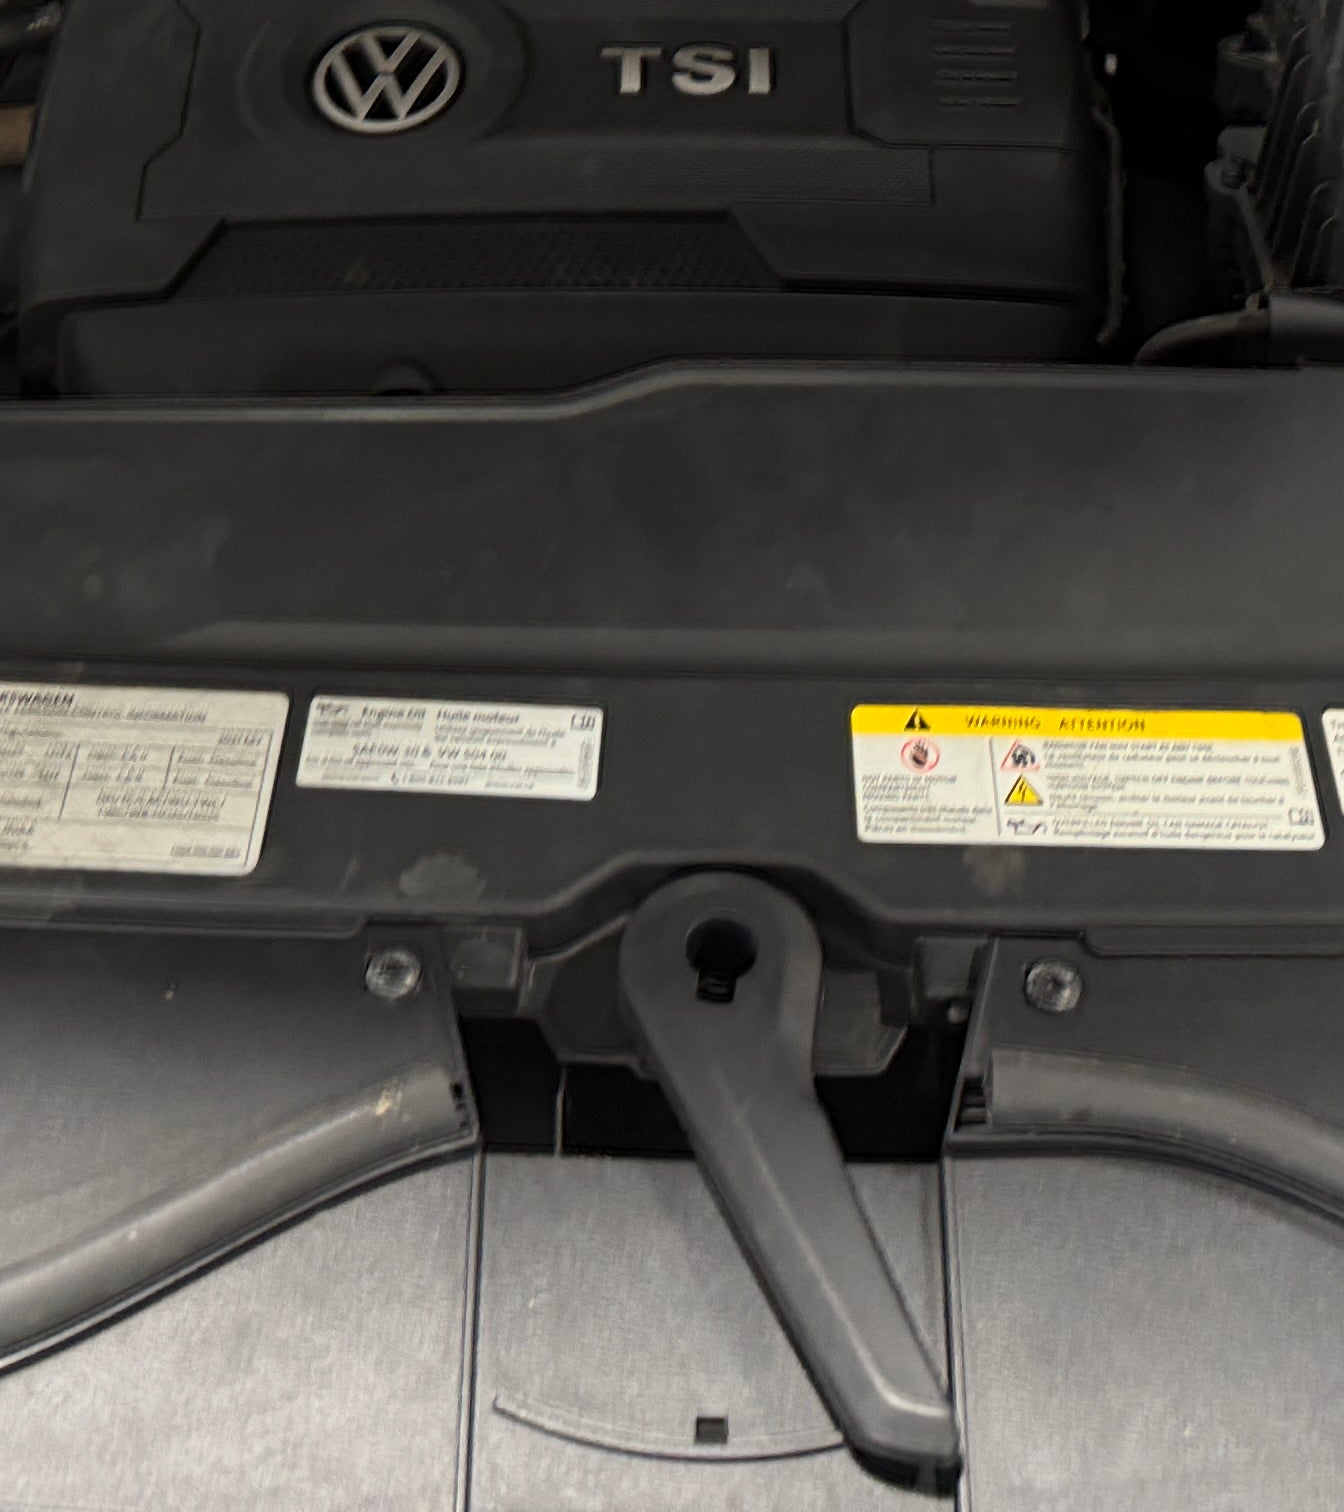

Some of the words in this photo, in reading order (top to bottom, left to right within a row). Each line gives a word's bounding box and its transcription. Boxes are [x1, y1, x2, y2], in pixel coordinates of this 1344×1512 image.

[600, 42, 776, 97] TSI
[964, 713, 1041, 730] WARNING
[1058, 716, 1146, 733] ATTENTION
